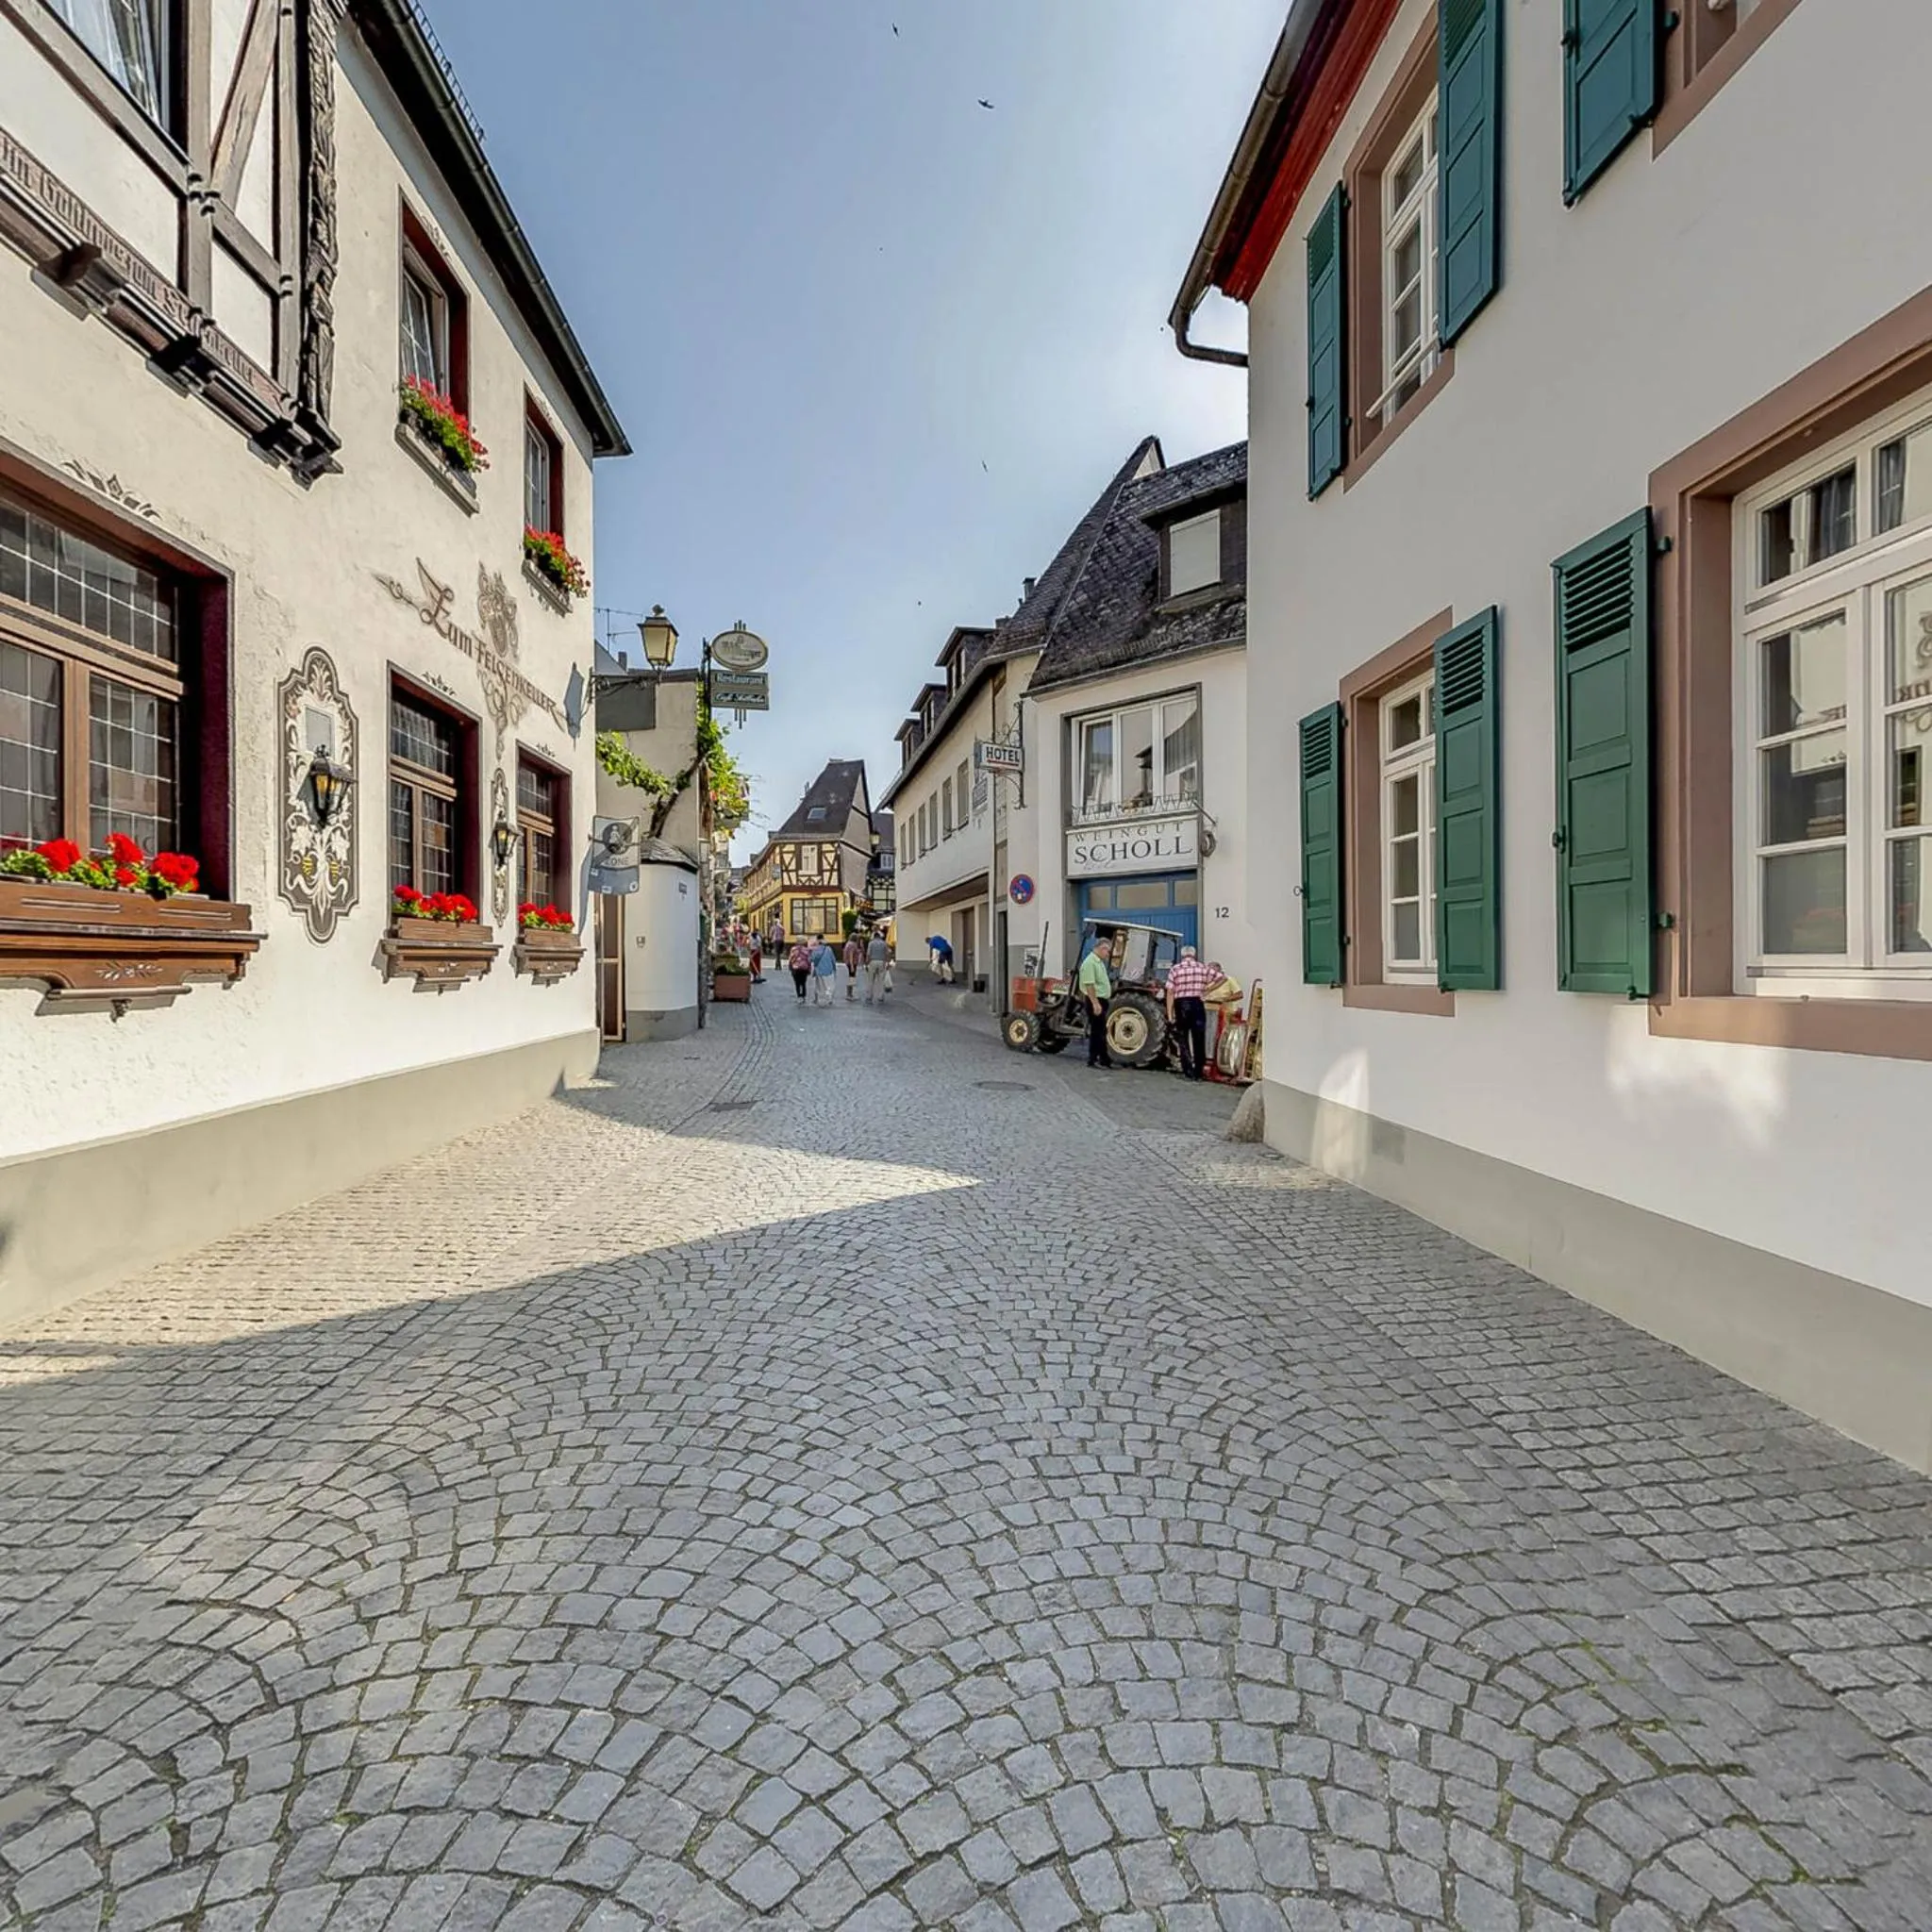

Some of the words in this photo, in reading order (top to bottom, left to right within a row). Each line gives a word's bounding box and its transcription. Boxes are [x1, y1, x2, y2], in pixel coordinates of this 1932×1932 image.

[986, 745, 1020, 762] HOTEL
[1075, 820, 1183, 842] WEINGUT
[1074, 835, 1194, 864] SCHOLL
[1215, 907, 1230, 919] 12
